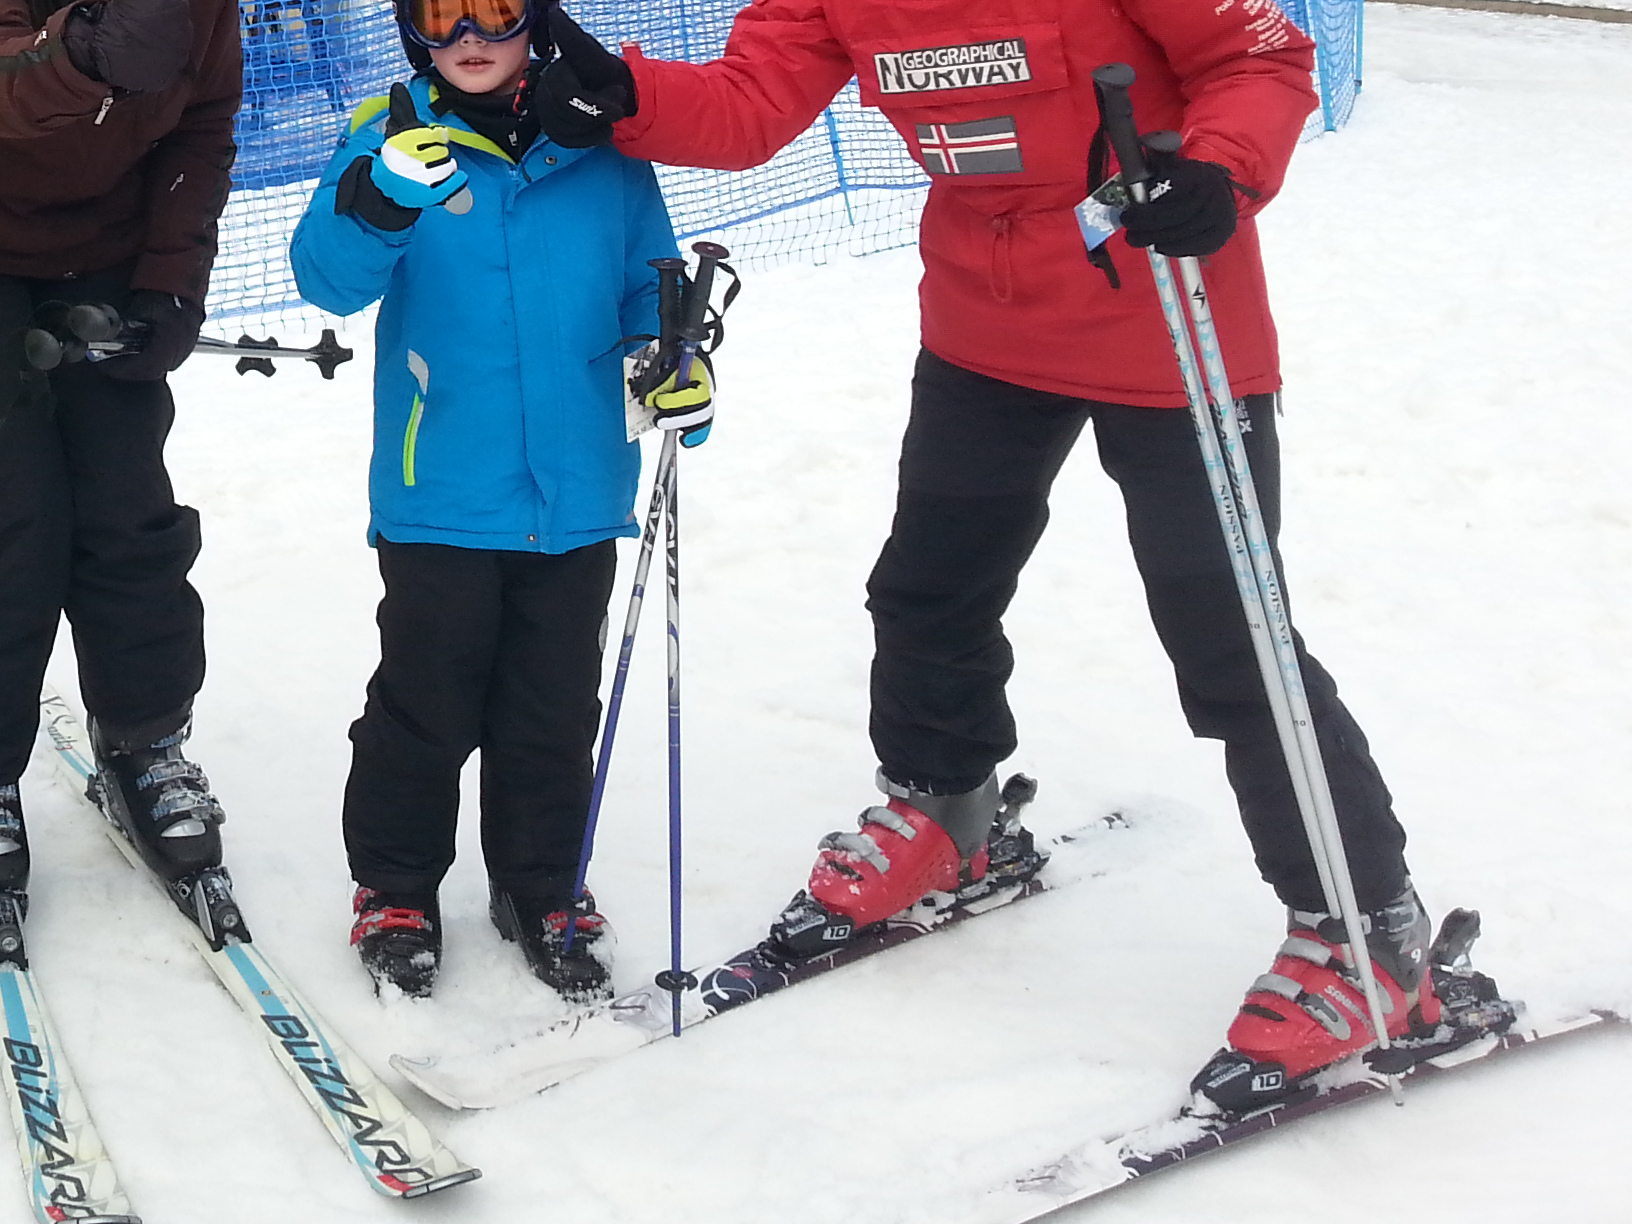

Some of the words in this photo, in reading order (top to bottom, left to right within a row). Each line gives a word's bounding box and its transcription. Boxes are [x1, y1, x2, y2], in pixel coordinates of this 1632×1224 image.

[902, 40, 1025, 69] GEOGRAPHICAL
[879, 56, 1022, 90] NORWAY
[1219, 484, 1245, 555] PASSION
[1265, 570, 1291, 645] PASSION
[1257, 1073, 1281, 1089] 10
